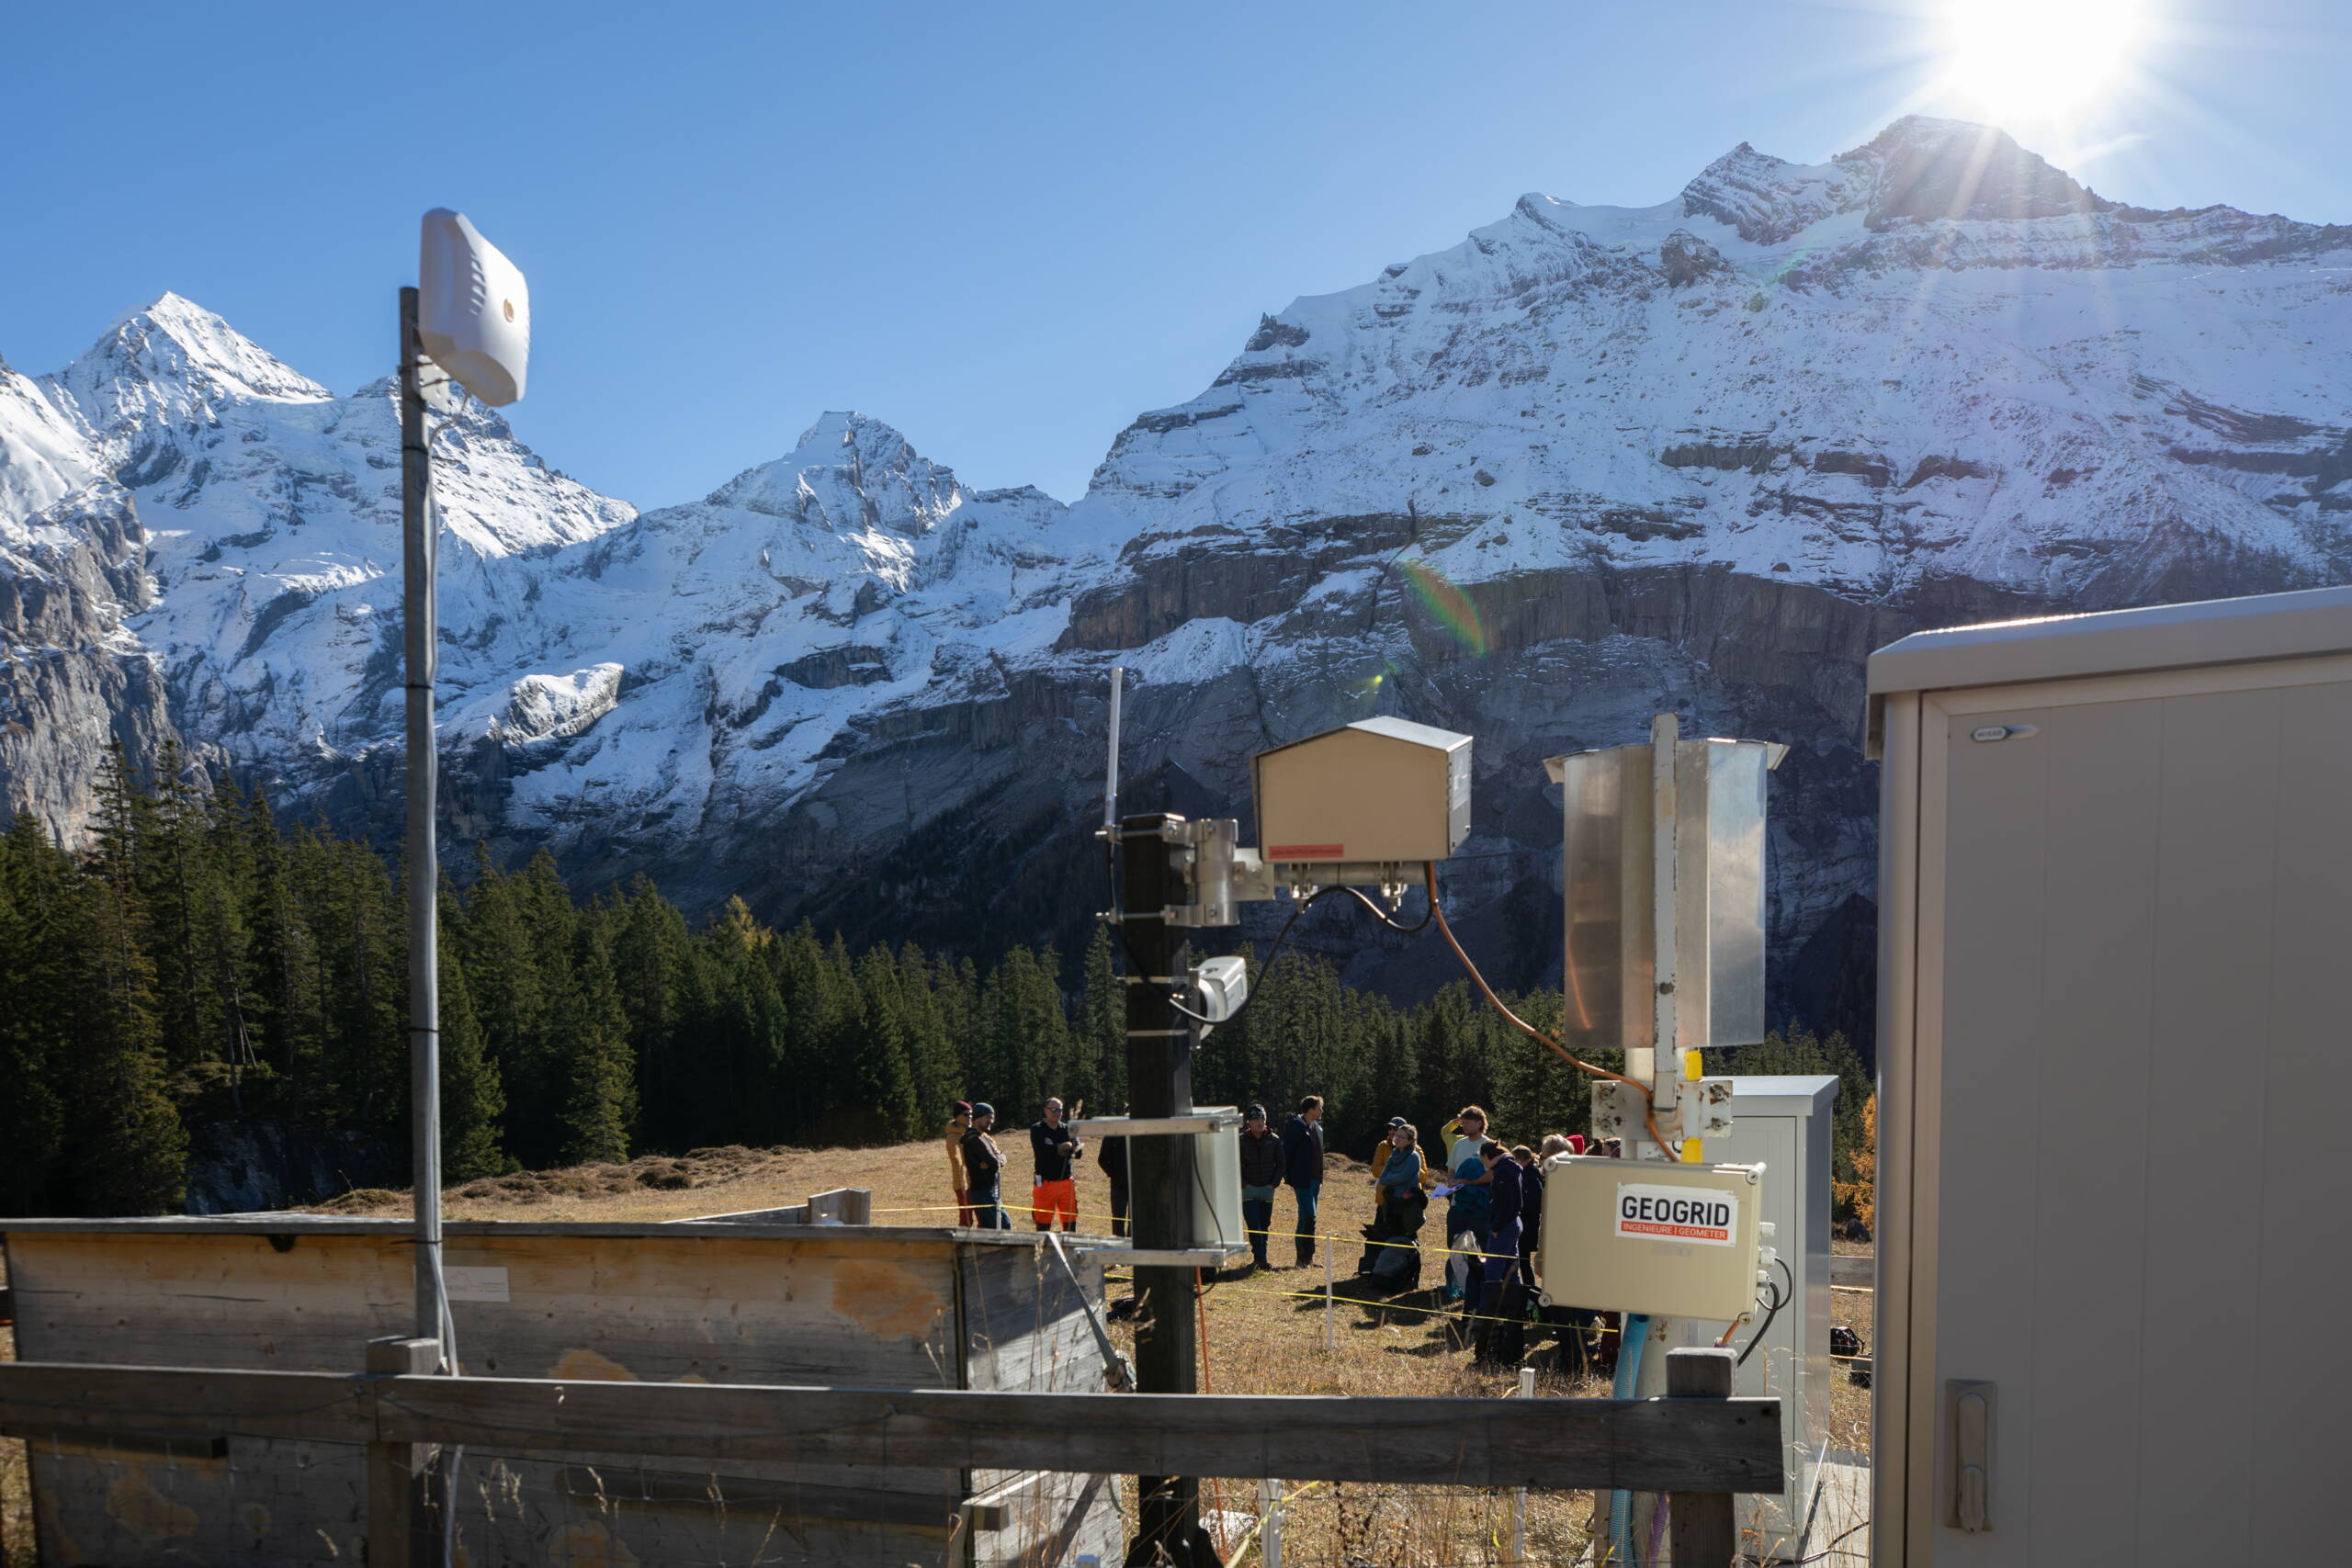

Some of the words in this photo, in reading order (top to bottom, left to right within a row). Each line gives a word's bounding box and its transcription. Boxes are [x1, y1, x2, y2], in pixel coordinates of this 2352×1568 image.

[1622, 1196, 1729, 1226] GEOGRID
[1623, 1223, 1672, 1235] INGENIEURE
[1679, 1226, 1726, 1238] GEOMETER
